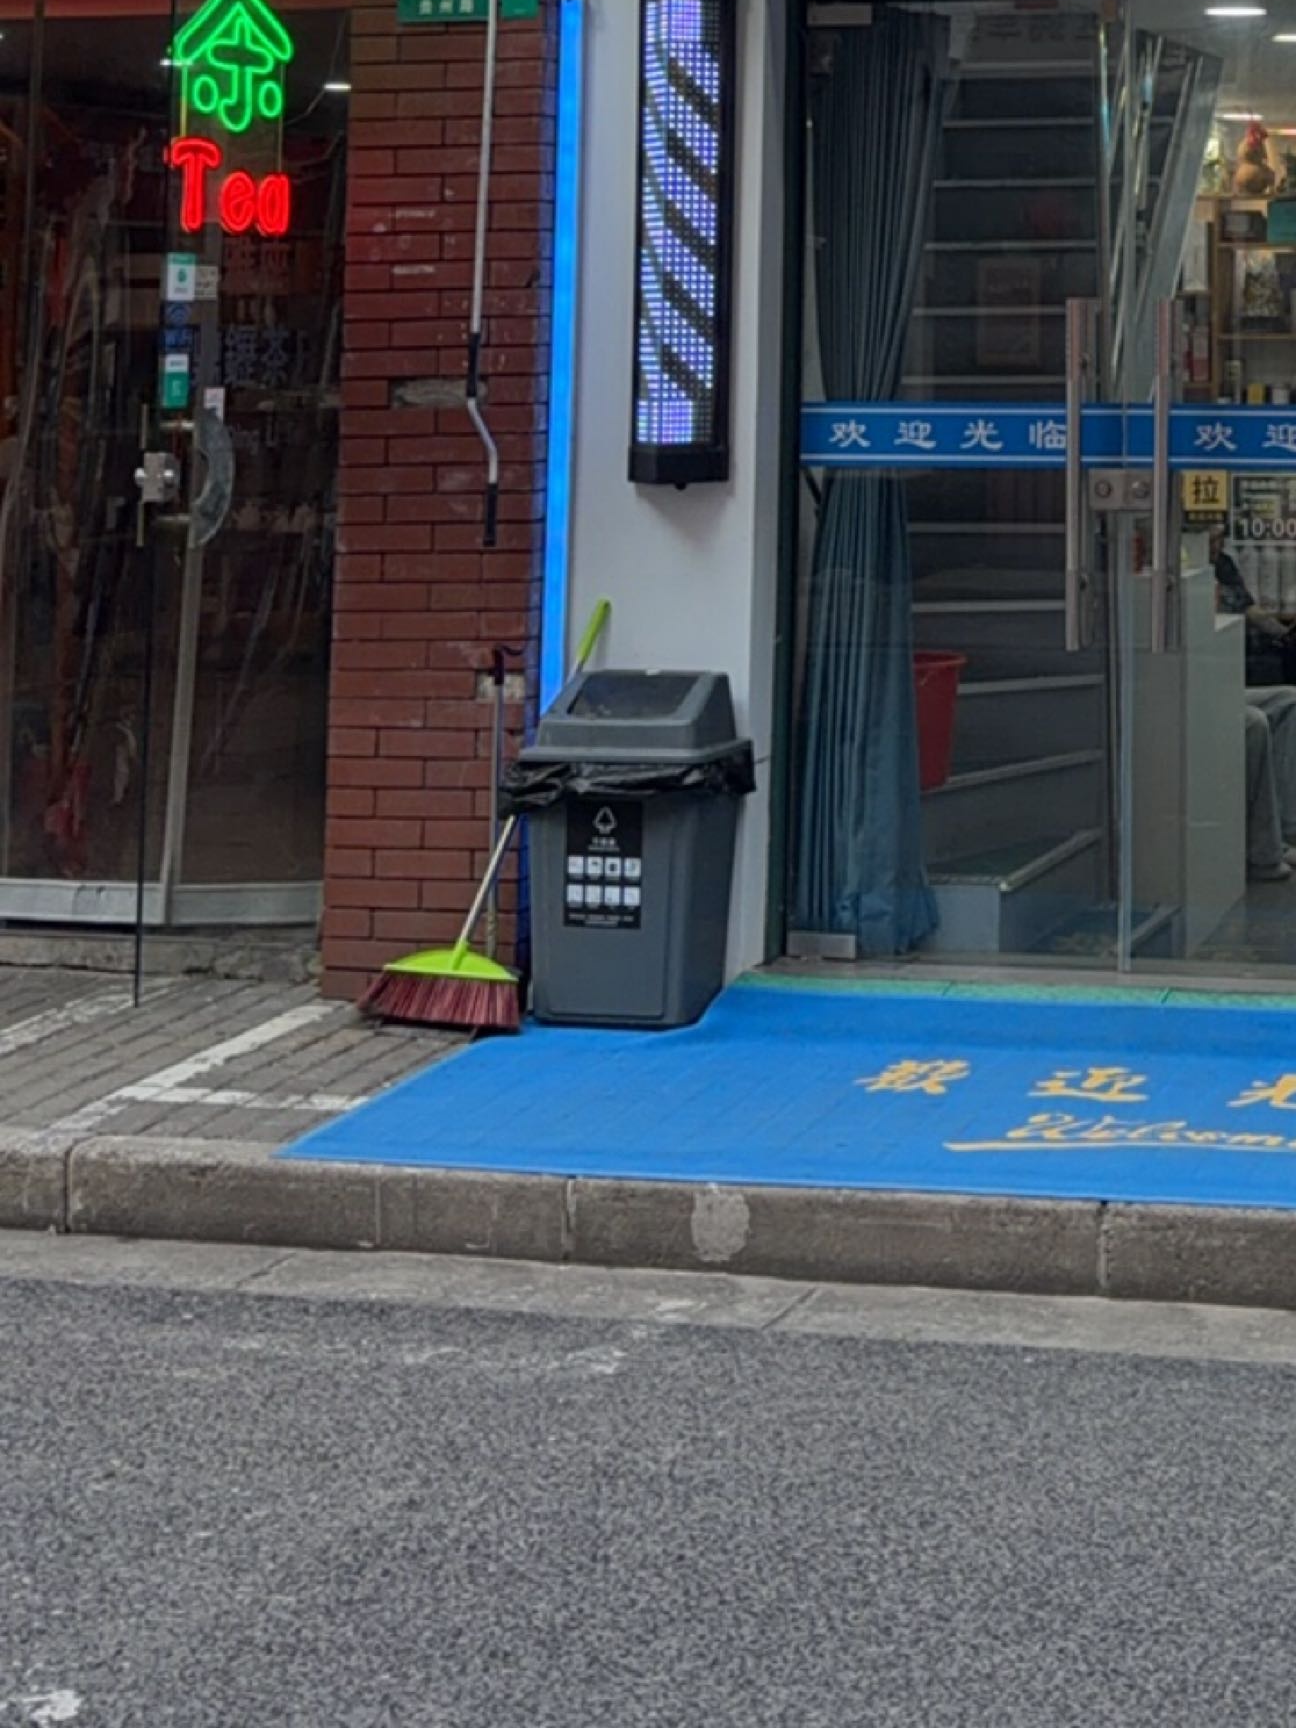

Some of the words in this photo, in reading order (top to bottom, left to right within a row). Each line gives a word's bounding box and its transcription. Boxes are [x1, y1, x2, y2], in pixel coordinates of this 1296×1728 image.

[166, 137, 291, 235] Tea
[828, 419, 1066, 449] 欢迎光临
[1192, 475, 1219, 504] 拉
